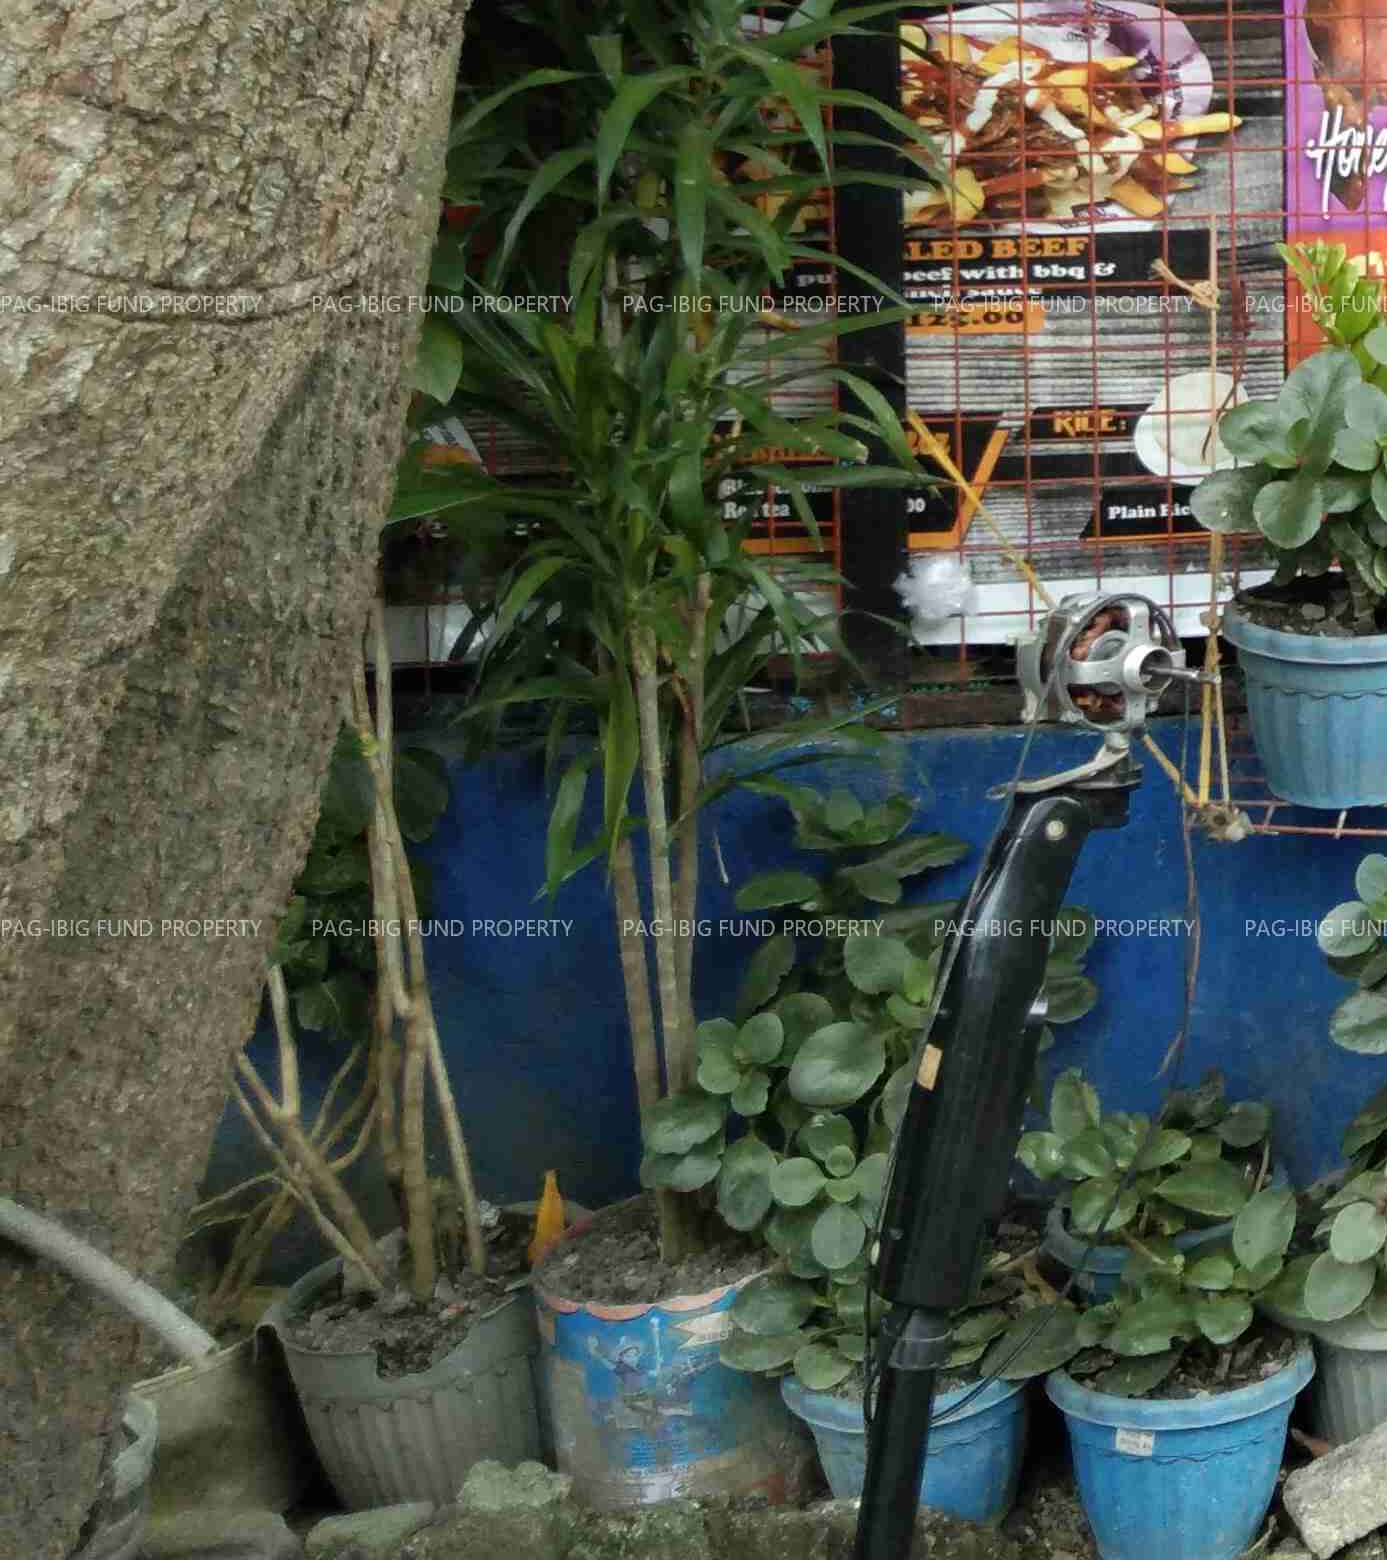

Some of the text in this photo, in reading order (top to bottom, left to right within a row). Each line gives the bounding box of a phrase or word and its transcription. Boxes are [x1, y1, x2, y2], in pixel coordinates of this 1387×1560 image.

[991, 236, 1090, 259] BEEF
[959, 266, 1025, 280] with
[1032, 264, 1086, 280] bbq
[1107, 503, 1192, 520] Plain Ric
